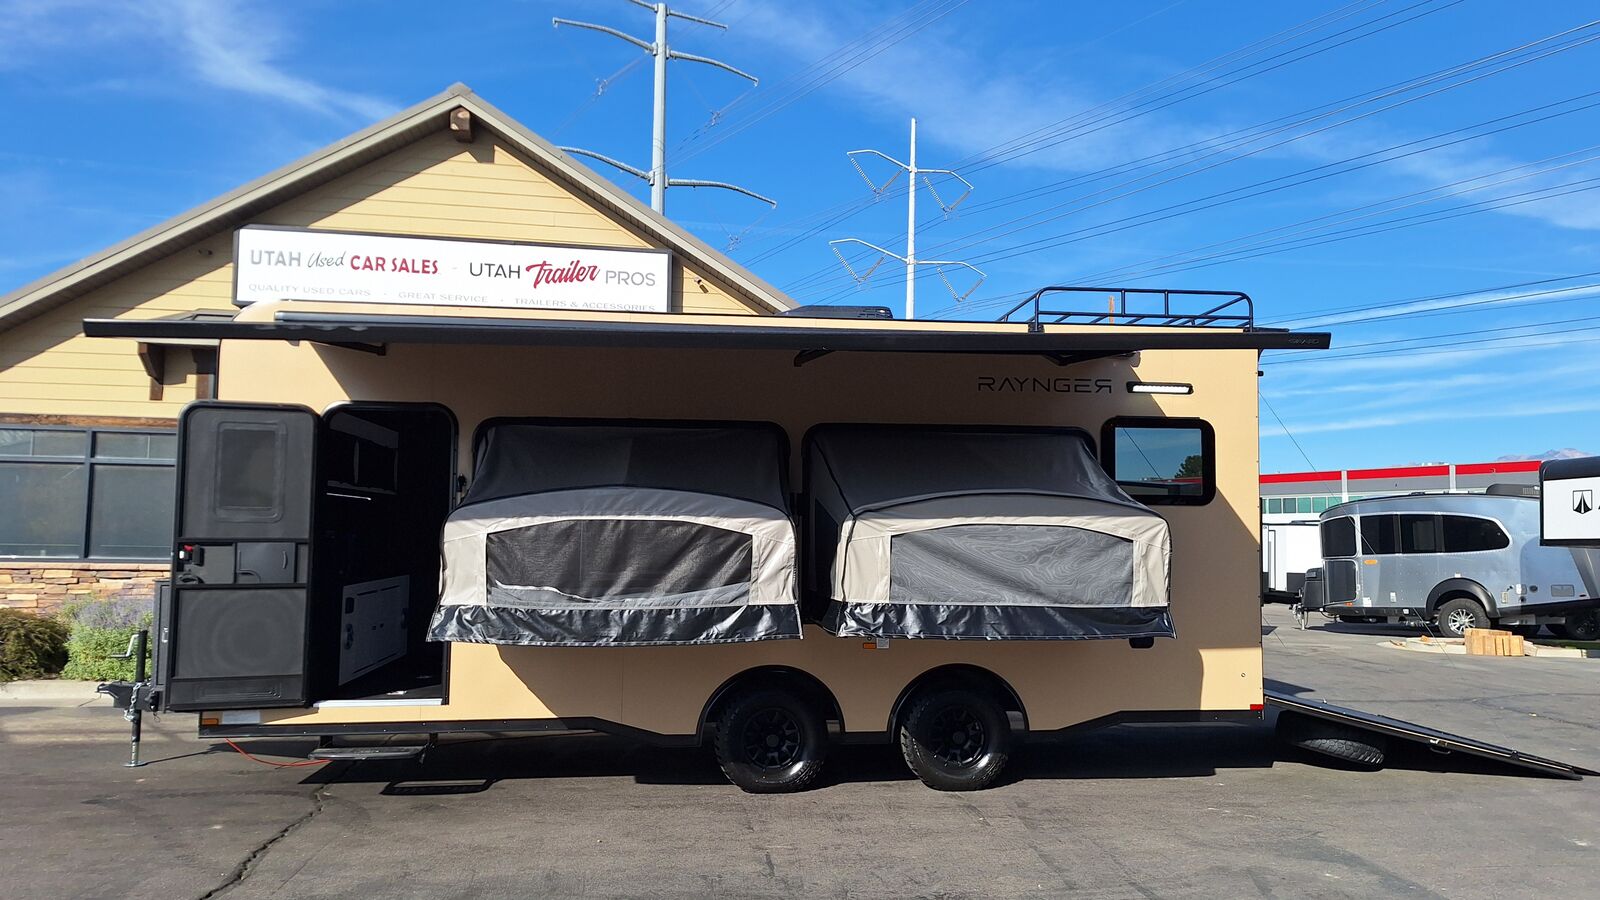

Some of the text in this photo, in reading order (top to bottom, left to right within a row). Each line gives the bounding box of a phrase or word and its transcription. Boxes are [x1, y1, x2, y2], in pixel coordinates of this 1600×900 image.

[250, 249, 439, 275] UTAH Used CAR SALES
[469, 260, 656, 290] UTAH Trailer PROS
[248, 283, 372, 297] QUALITY USED CARS
[398, 291, 488, 303] GREAT SERVICE
[514, 297, 567, 307] TRAILERS
[570, 299, 579, 308] &
